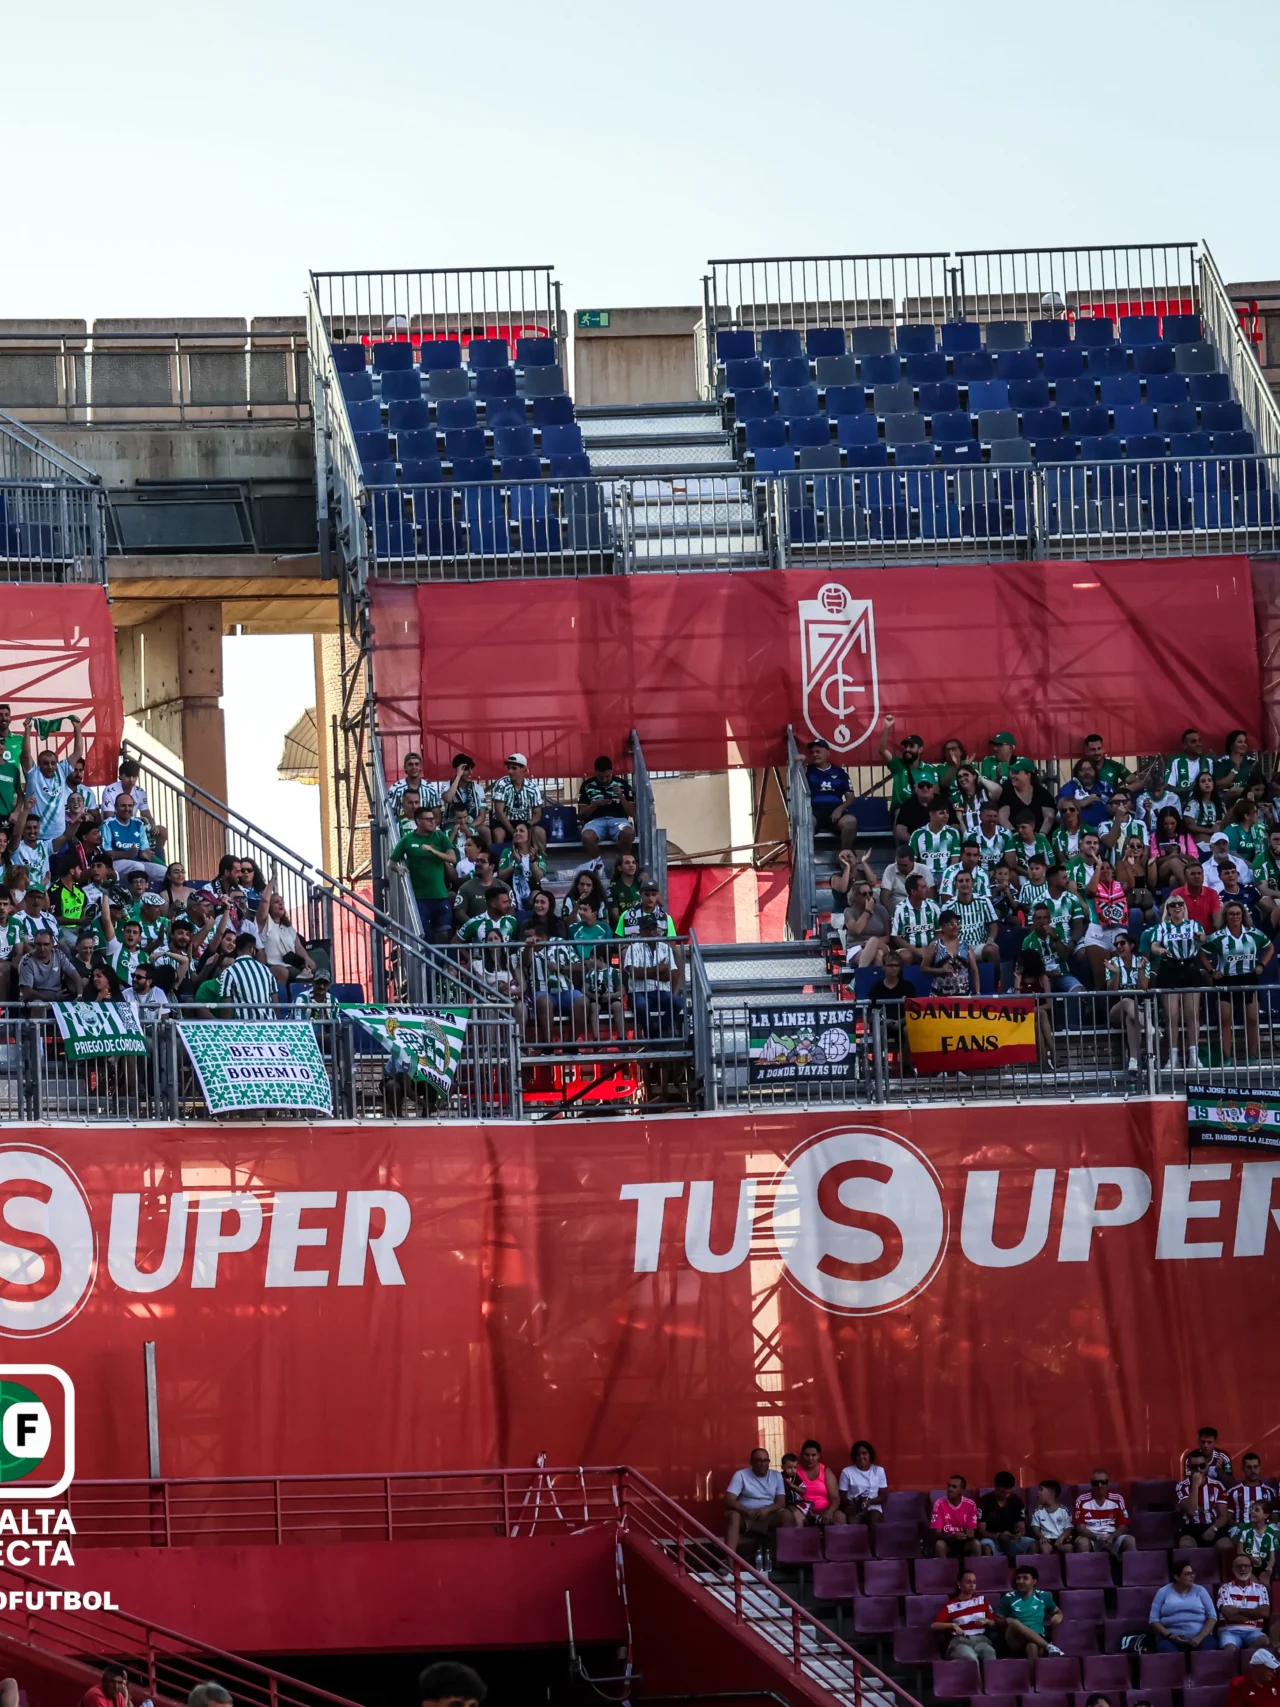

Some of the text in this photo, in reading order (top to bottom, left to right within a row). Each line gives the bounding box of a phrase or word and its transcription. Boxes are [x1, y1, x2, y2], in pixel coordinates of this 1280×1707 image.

[359, 1007, 383, 1015] LA
[751, 1009, 853, 1026] LA LÍNEA FANS
[908, 1003, 1028, 1023] SANLUCAR
[74, 1036, 146, 1055] PRIEGO DE CÓRDOBA
[229, 1046, 290, 1057] BETIS
[941, 1035, 999, 1054] FANS
[228, 1067, 311, 1079] BOHEMIO
[757, 1065, 849, 1079] A DONDE VAYAS VOY
[1206, 1086, 1226, 1094] JOSE
[1194, 1105, 1209, 1119] 19
[1215, 1134, 1238, 1142] BARRIO
[620, 1178, 750, 1273] TU
